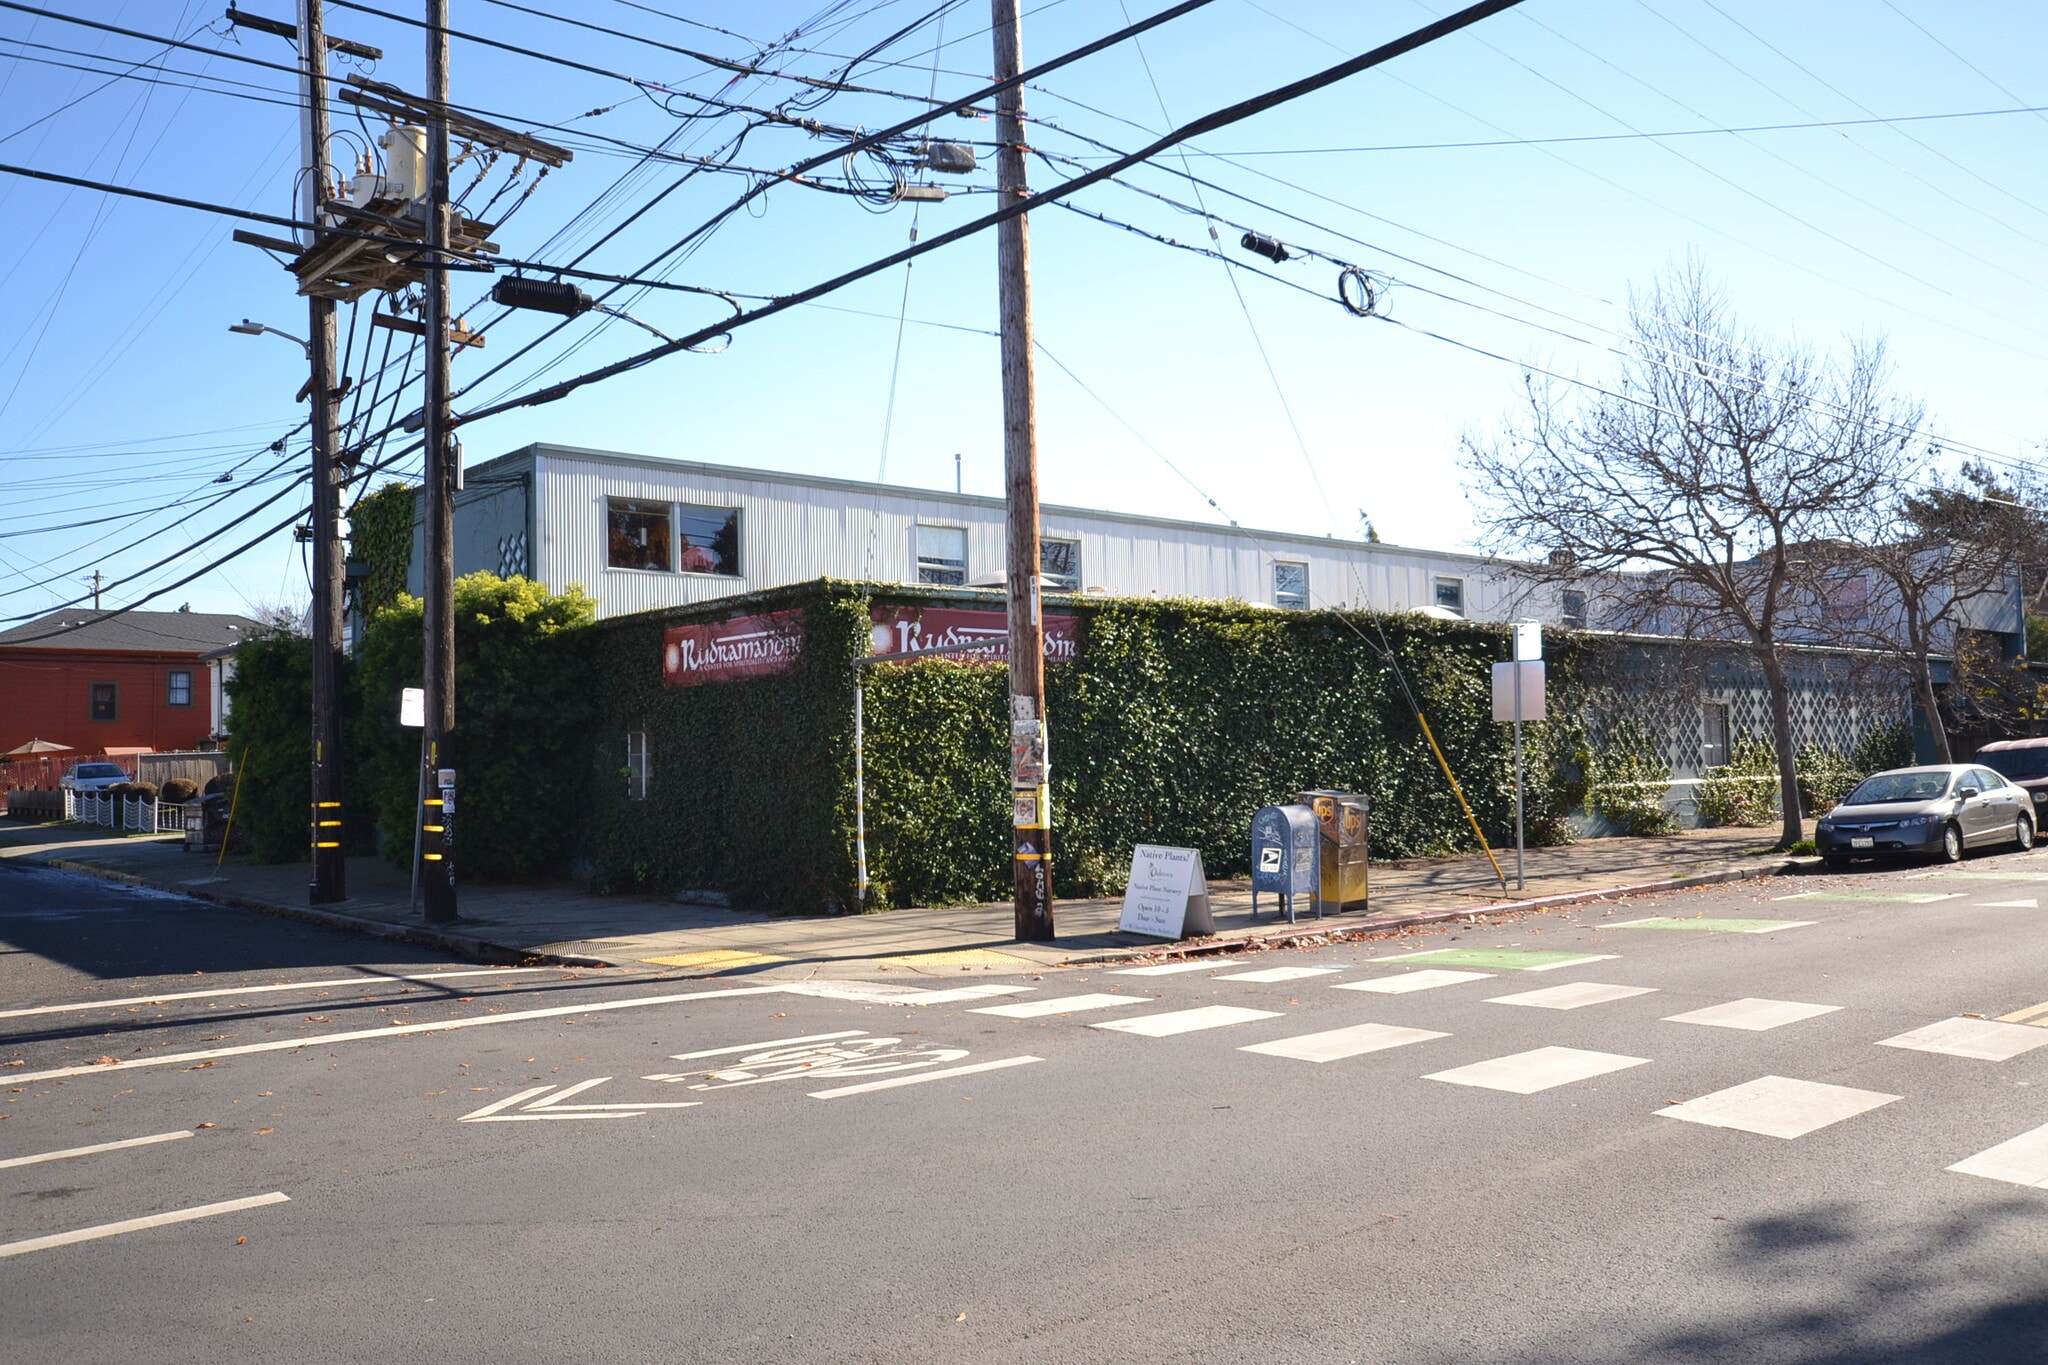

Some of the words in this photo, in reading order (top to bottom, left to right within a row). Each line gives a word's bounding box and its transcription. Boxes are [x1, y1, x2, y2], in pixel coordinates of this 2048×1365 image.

[723, 661, 734, 669] FOR
[1141, 849, 1163, 860] Native
[1133, 882, 1148, 890] Native
[1149, 884, 1162, 892] Plant
[1163, 886, 1182, 895] Nursery
[1137, 903, 1153, 912] Open
[1155, 915, 1166, 924] Sun
